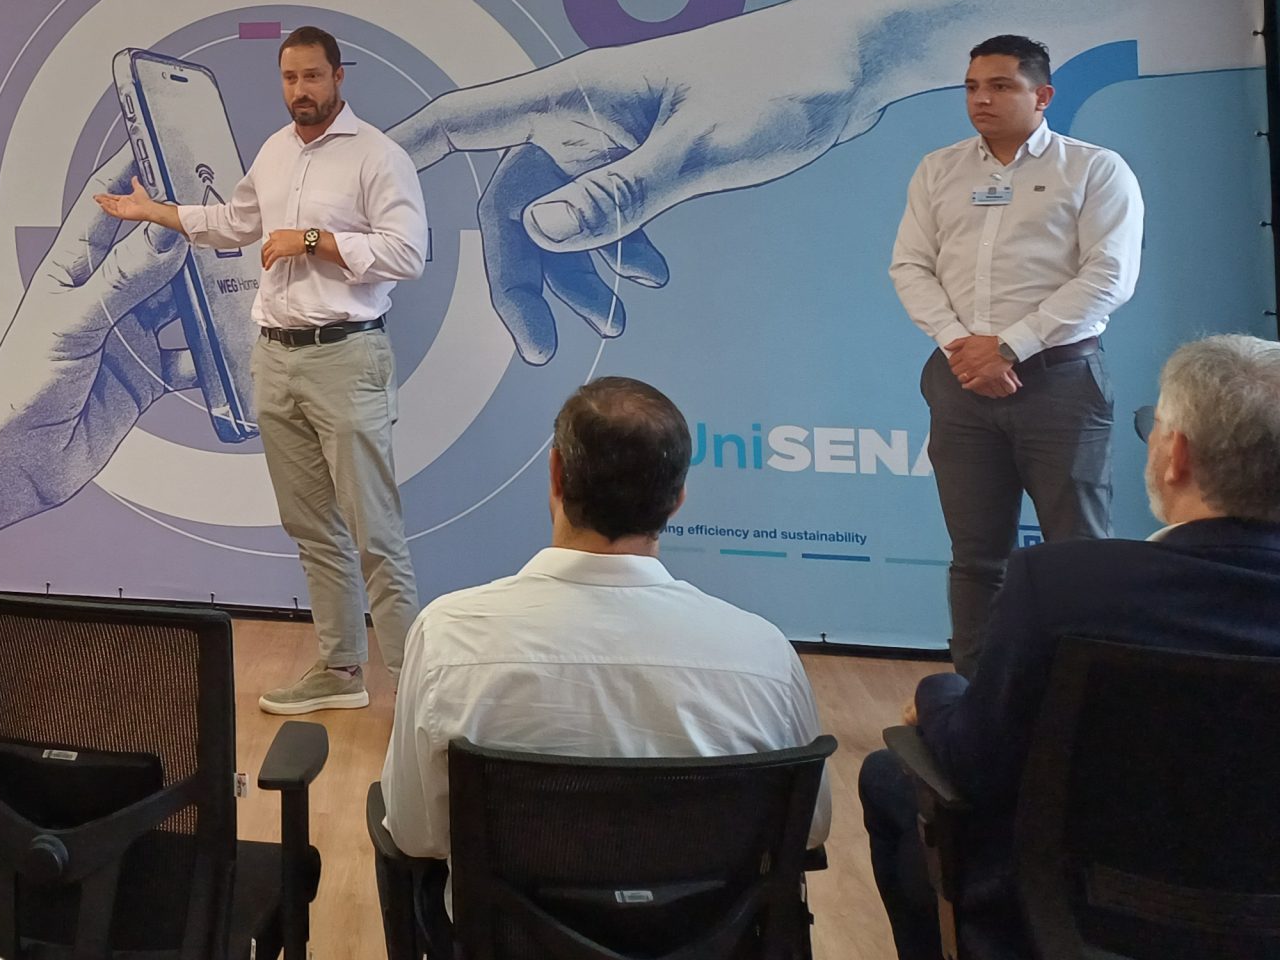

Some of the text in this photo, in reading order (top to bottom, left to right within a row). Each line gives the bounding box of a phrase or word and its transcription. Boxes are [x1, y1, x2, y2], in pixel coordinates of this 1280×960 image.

[217, 278, 239, 294] WEG
[659, 524, 868, 546] ing efficiency and sustainability
